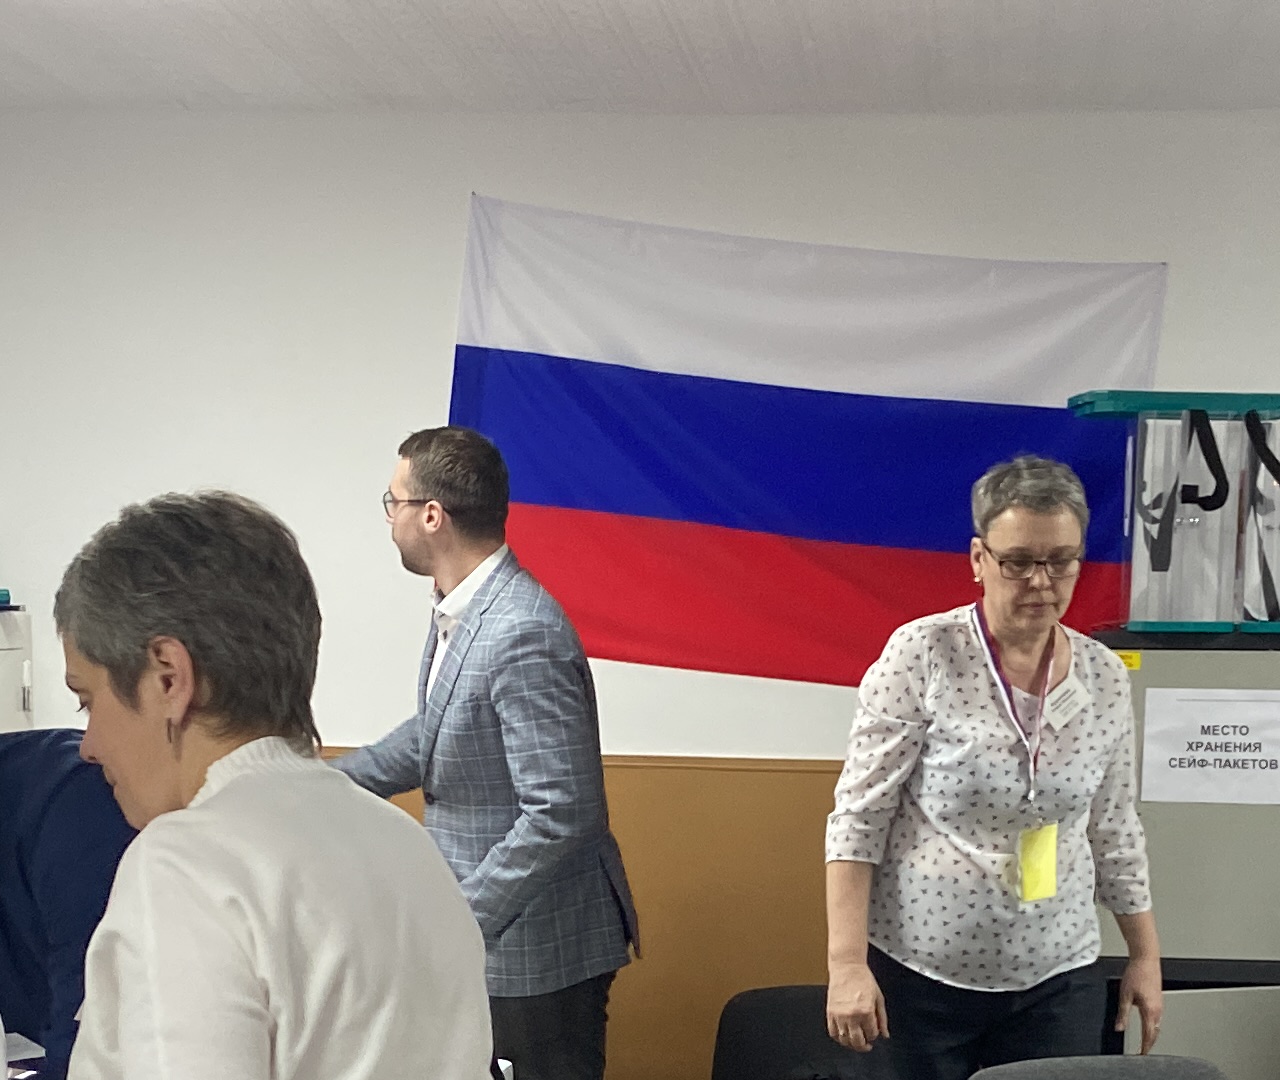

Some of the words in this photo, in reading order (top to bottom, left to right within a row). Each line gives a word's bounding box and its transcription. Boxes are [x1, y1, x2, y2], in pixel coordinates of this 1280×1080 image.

[1201, 725, 1249, 736] МЕСТО
[1186, 741, 1262, 753] ХРАНЕНИЯ
[1169, 756, 1278, 769] СЕЙФ-ПАКЕТОВ
